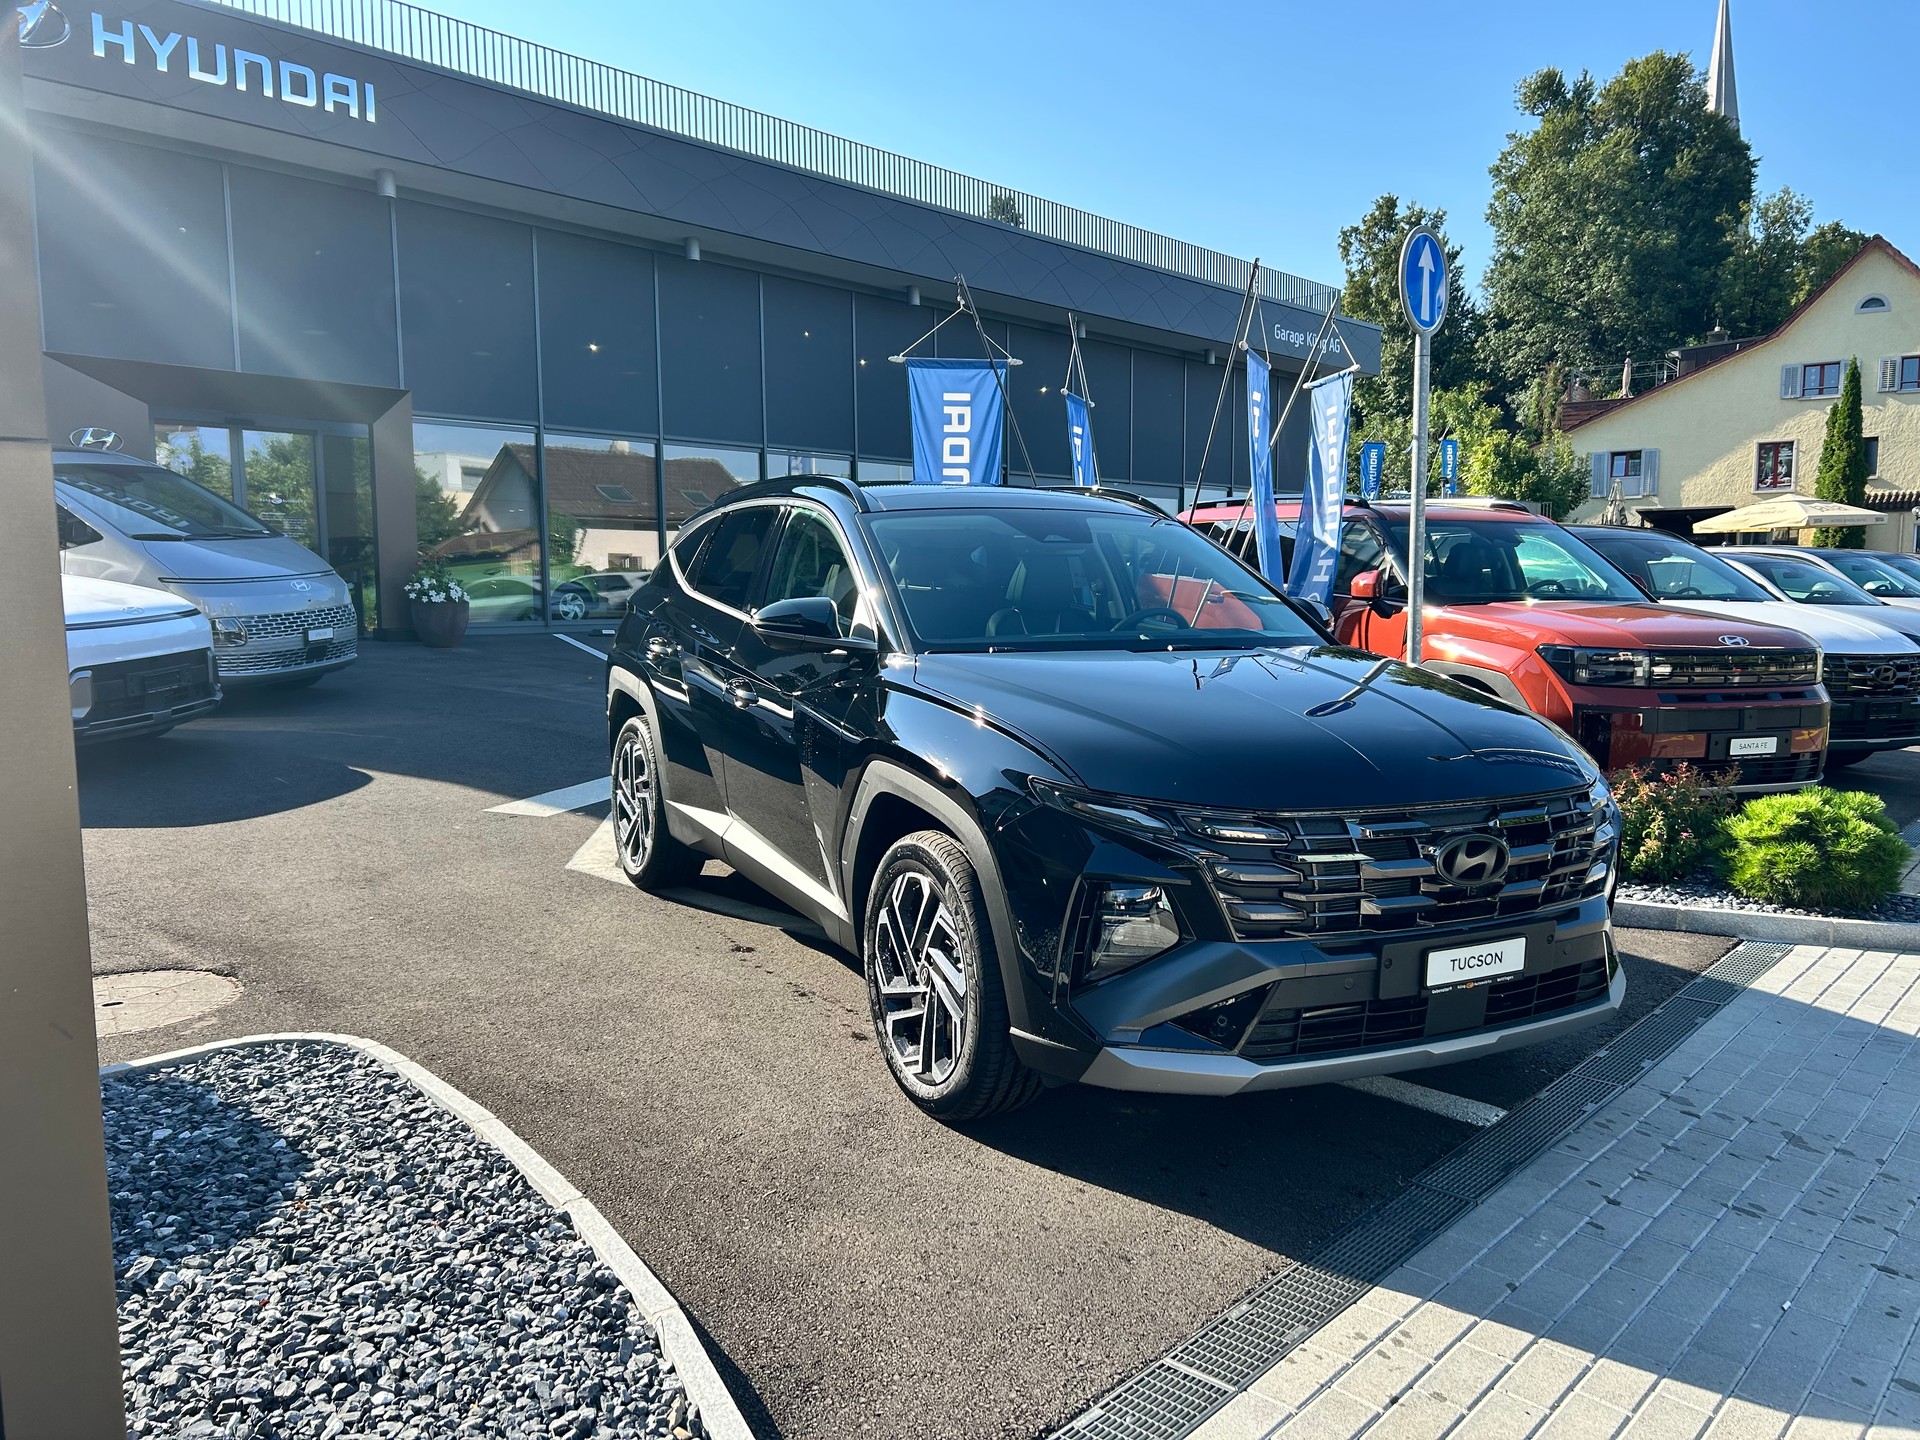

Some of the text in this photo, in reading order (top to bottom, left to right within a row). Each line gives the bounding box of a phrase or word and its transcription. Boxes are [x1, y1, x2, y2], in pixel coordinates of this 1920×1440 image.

[91, 12, 376, 123] HYUNDAI
[1274, 324, 1305, 348] Garage
[1328, 337, 1341, 354] AG
[942, 392, 972, 485] NDAI
[1368, 448, 1379, 489] HYUNDAI
[1312, 404, 1340, 582] HYUNDAI
[1739, 741, 1768, 750] SANTA FE
[1450, 951, 1504, 972] TUCSON
